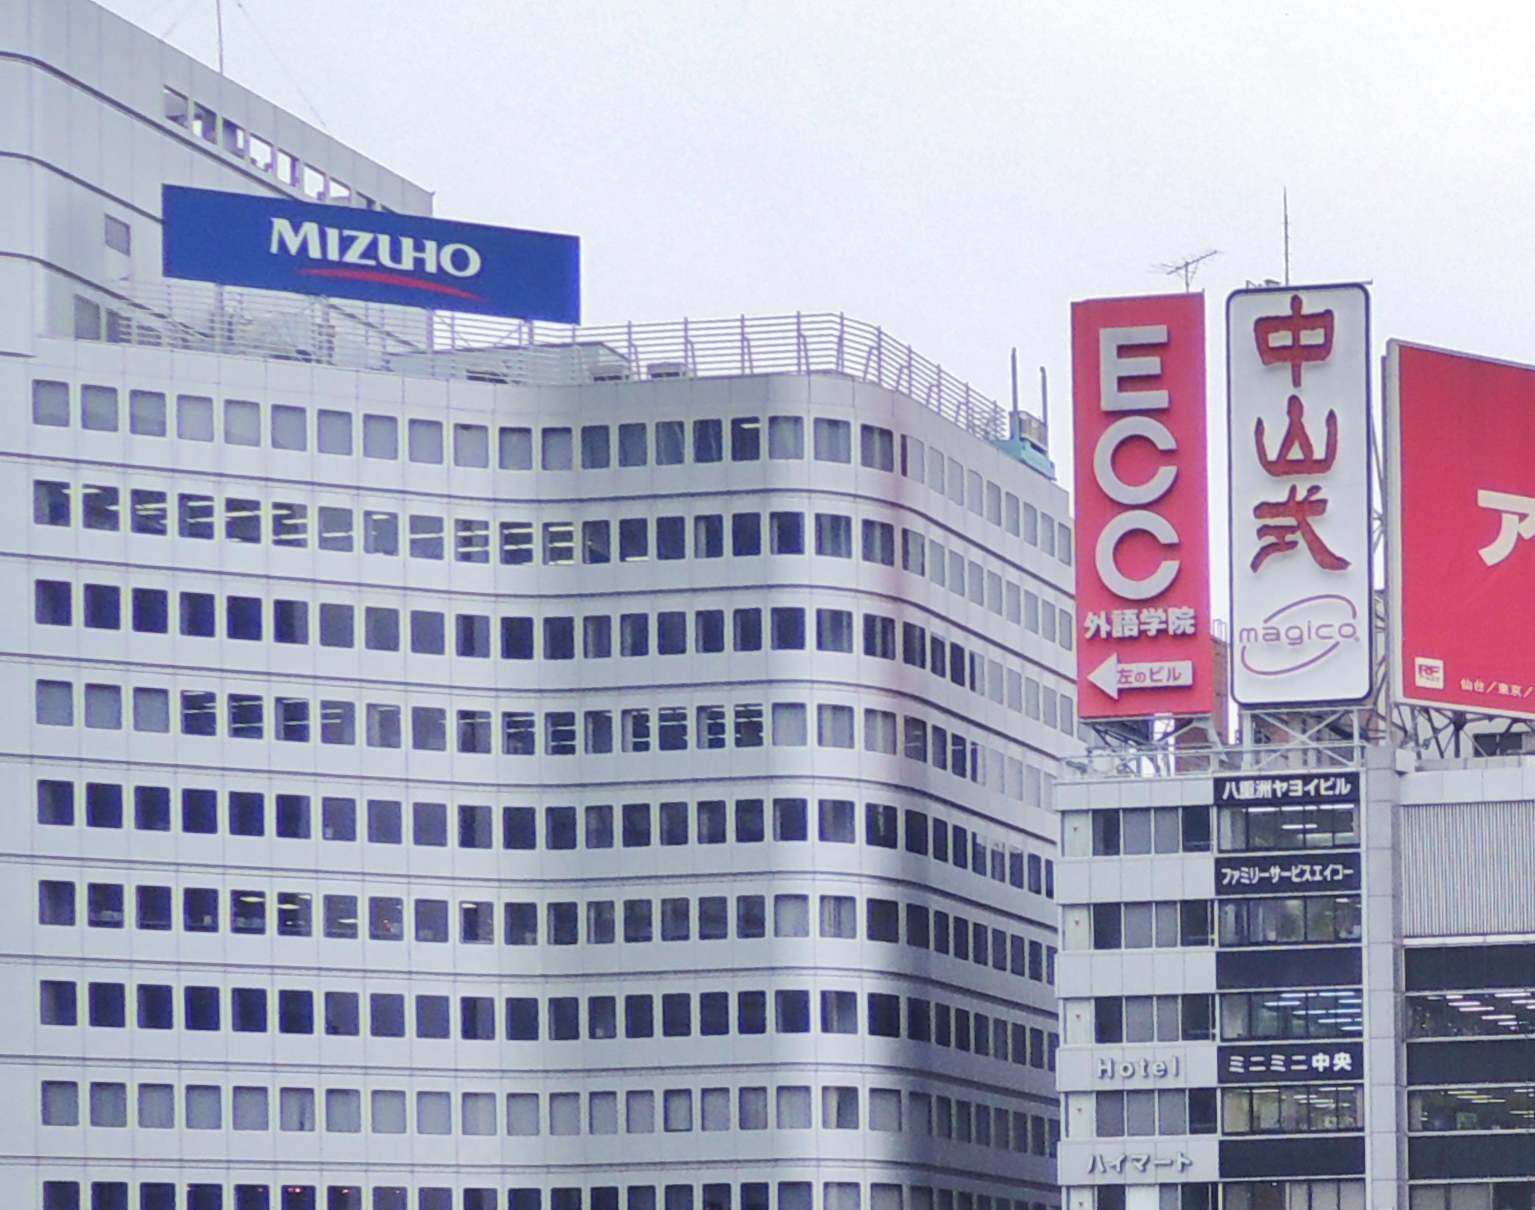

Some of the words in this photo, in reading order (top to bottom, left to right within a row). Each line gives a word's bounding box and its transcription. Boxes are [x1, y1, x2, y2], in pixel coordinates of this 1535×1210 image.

[269, 216, 482, 279] MIZUHO
[1249, 295, 1352, 575] 中山式
[1093, 324, 1180, 600] ECC
[1084, 605, 1197, 641] 外語学院
[1239, 621, 1357, 647] magico
[1116, 666, 1183, 686] 左のビル
[1222, 779, 1351, 800] 八重洲ヤヨイビル
[1221, 864, 1354, 886] ファミリーサービスエイコー
[1097, 1057, 1180, 1079] Hotel
[1229, 1053, 1353, 1073] ミニミニ中央
[1087, 1153, 1193, 1174] ハイマート
